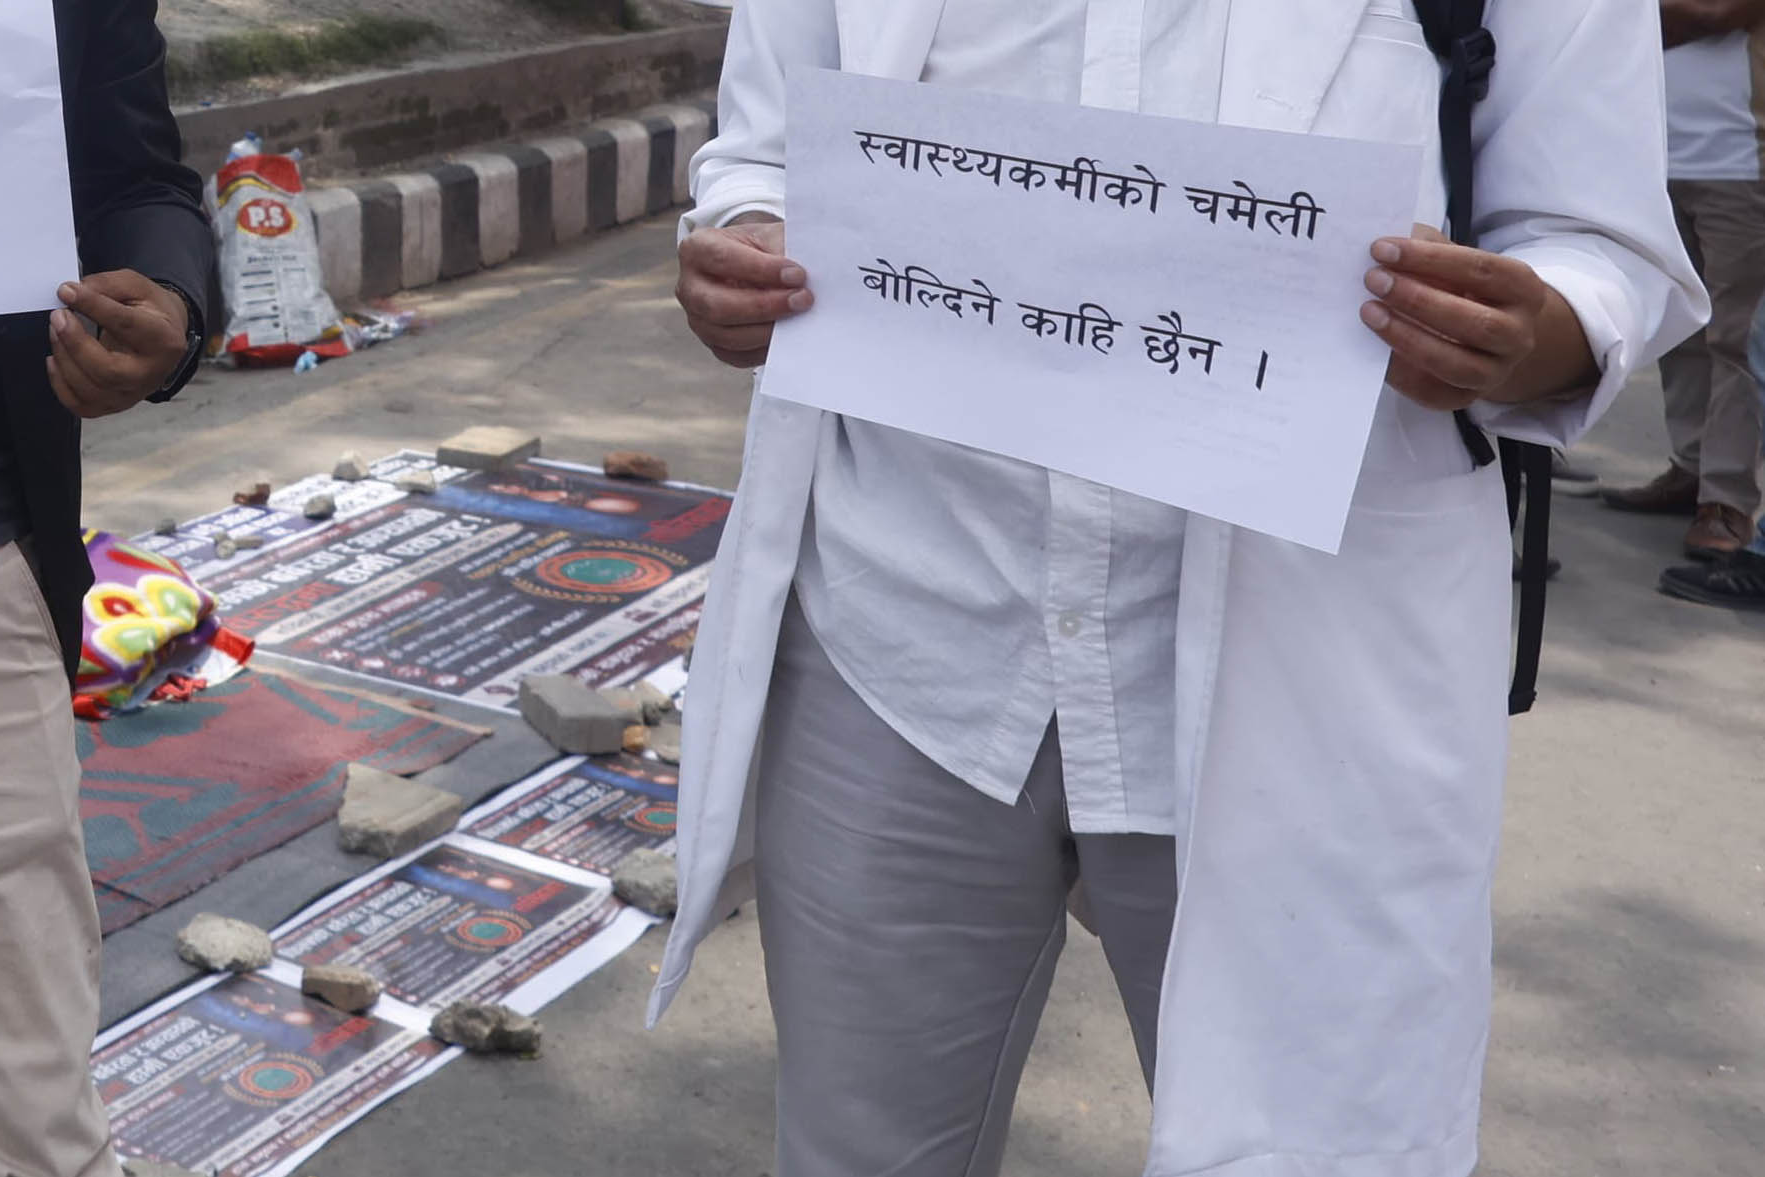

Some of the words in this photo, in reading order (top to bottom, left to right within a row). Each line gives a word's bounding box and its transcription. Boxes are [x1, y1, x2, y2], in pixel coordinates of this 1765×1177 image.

[853, 130, 1167, 215] स्वास्थ्यकर्मीको
[1182, 180, 1327, 241] चमेली
[857, 257, 1003, 326] बोल्दिने
[1017, 302, 1124, 356] काहि
[1138, 310, 1223, 376] छैन
